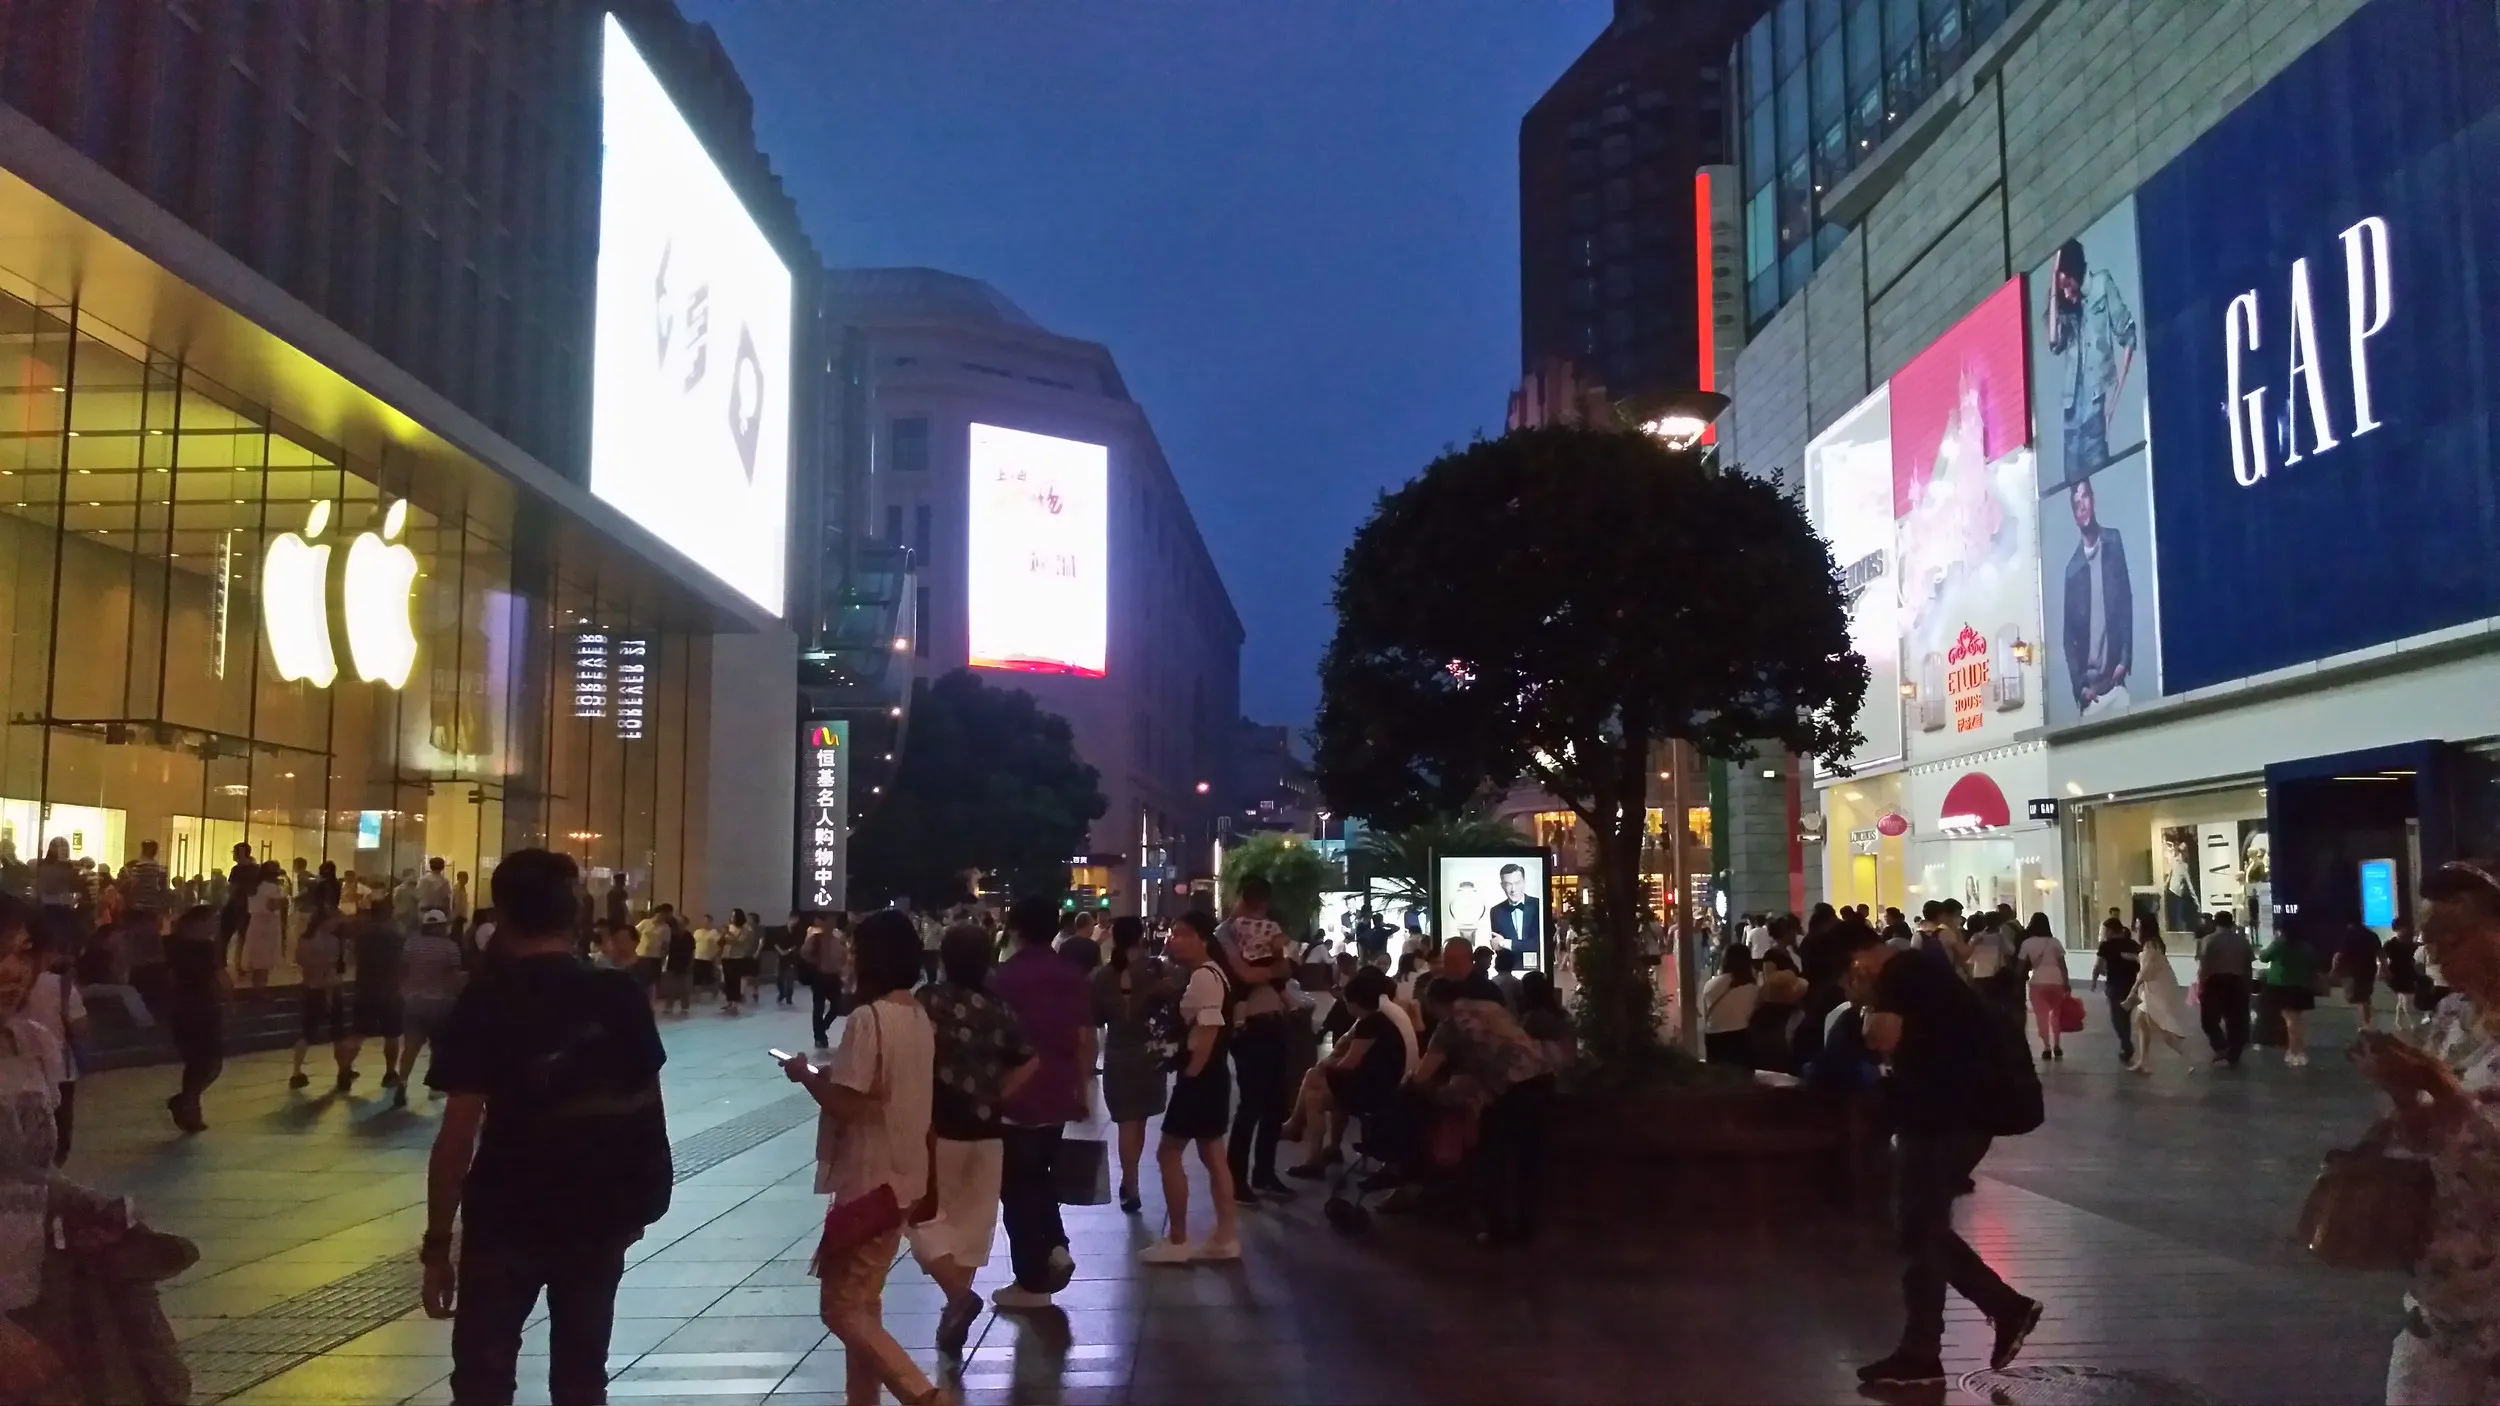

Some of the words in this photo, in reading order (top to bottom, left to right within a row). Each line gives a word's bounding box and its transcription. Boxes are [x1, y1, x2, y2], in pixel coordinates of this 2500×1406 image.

[2225, 216, 2391, 487] GAP
[1948, 659, 1990, 696] ETUDE
[2040, 803, 2055, 814] GAP
[813, 748, 836, 907] 恒基名人购物中心
[2285, 904, 2298, 914] GAP
